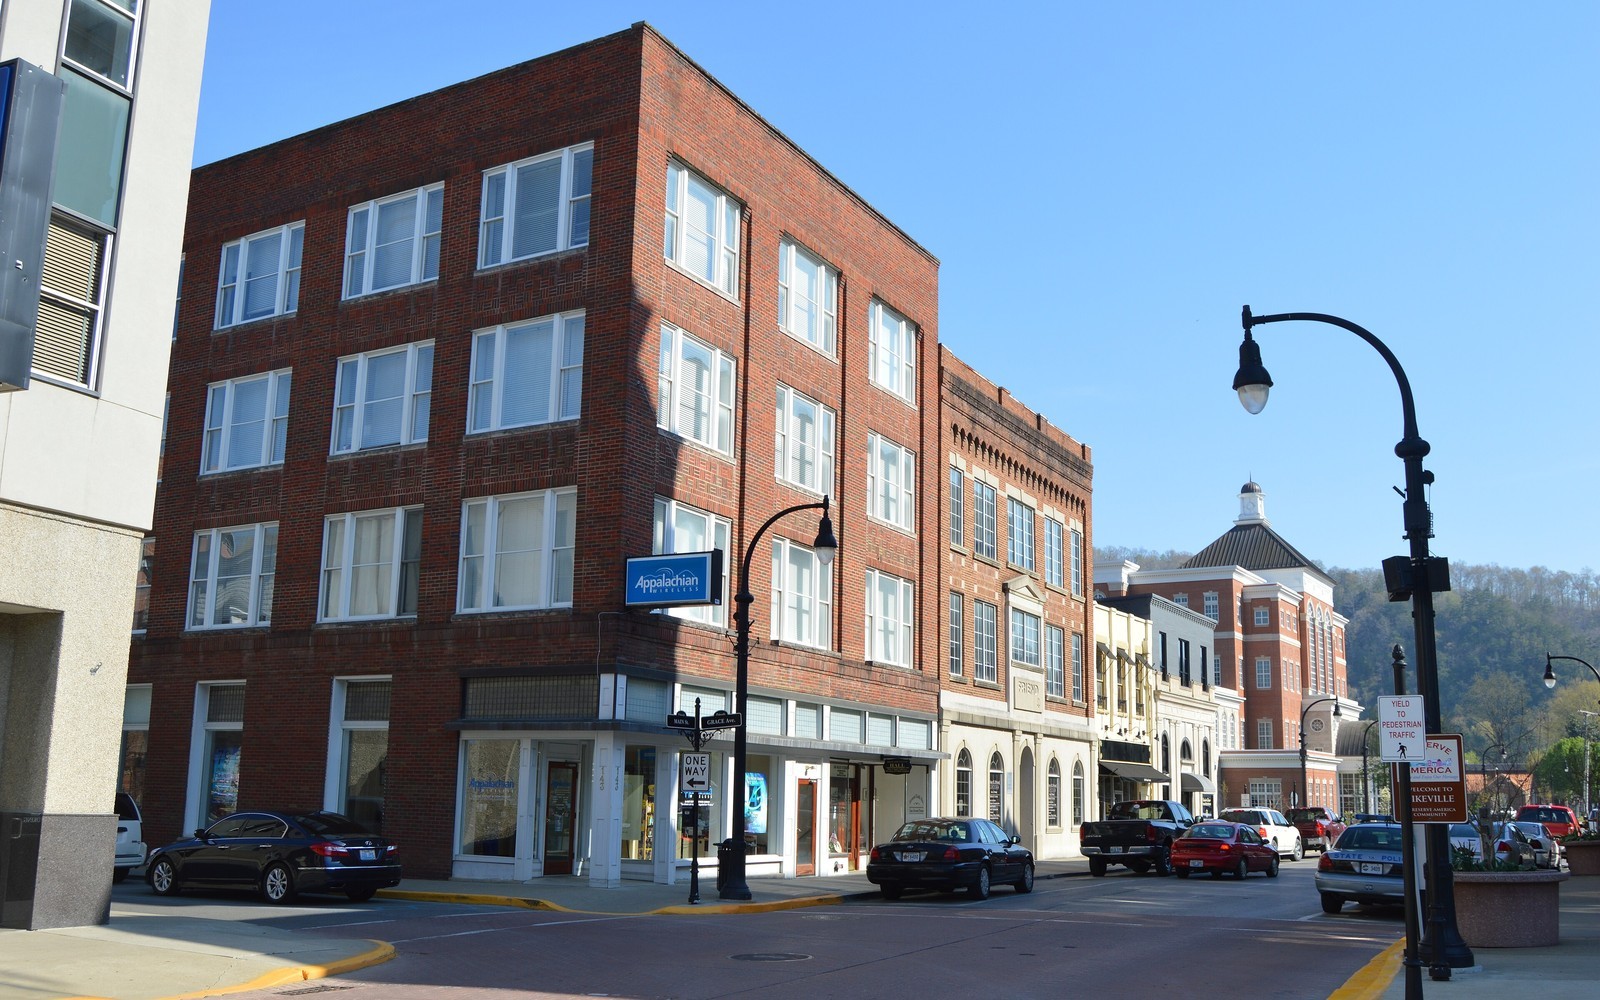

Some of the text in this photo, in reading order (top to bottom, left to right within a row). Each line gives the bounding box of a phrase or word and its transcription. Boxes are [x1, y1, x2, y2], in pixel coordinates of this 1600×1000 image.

[635, 573, 699, 593] Appalachian
[1426, 741, 1452, 755] ERVE
[685, 756, 706, 765] ONE
[685, 767, 706, 775] WAY
[469, 777, 515, 792] Appalachian
[1412, 795, 1455, 803] IKEVILLE
